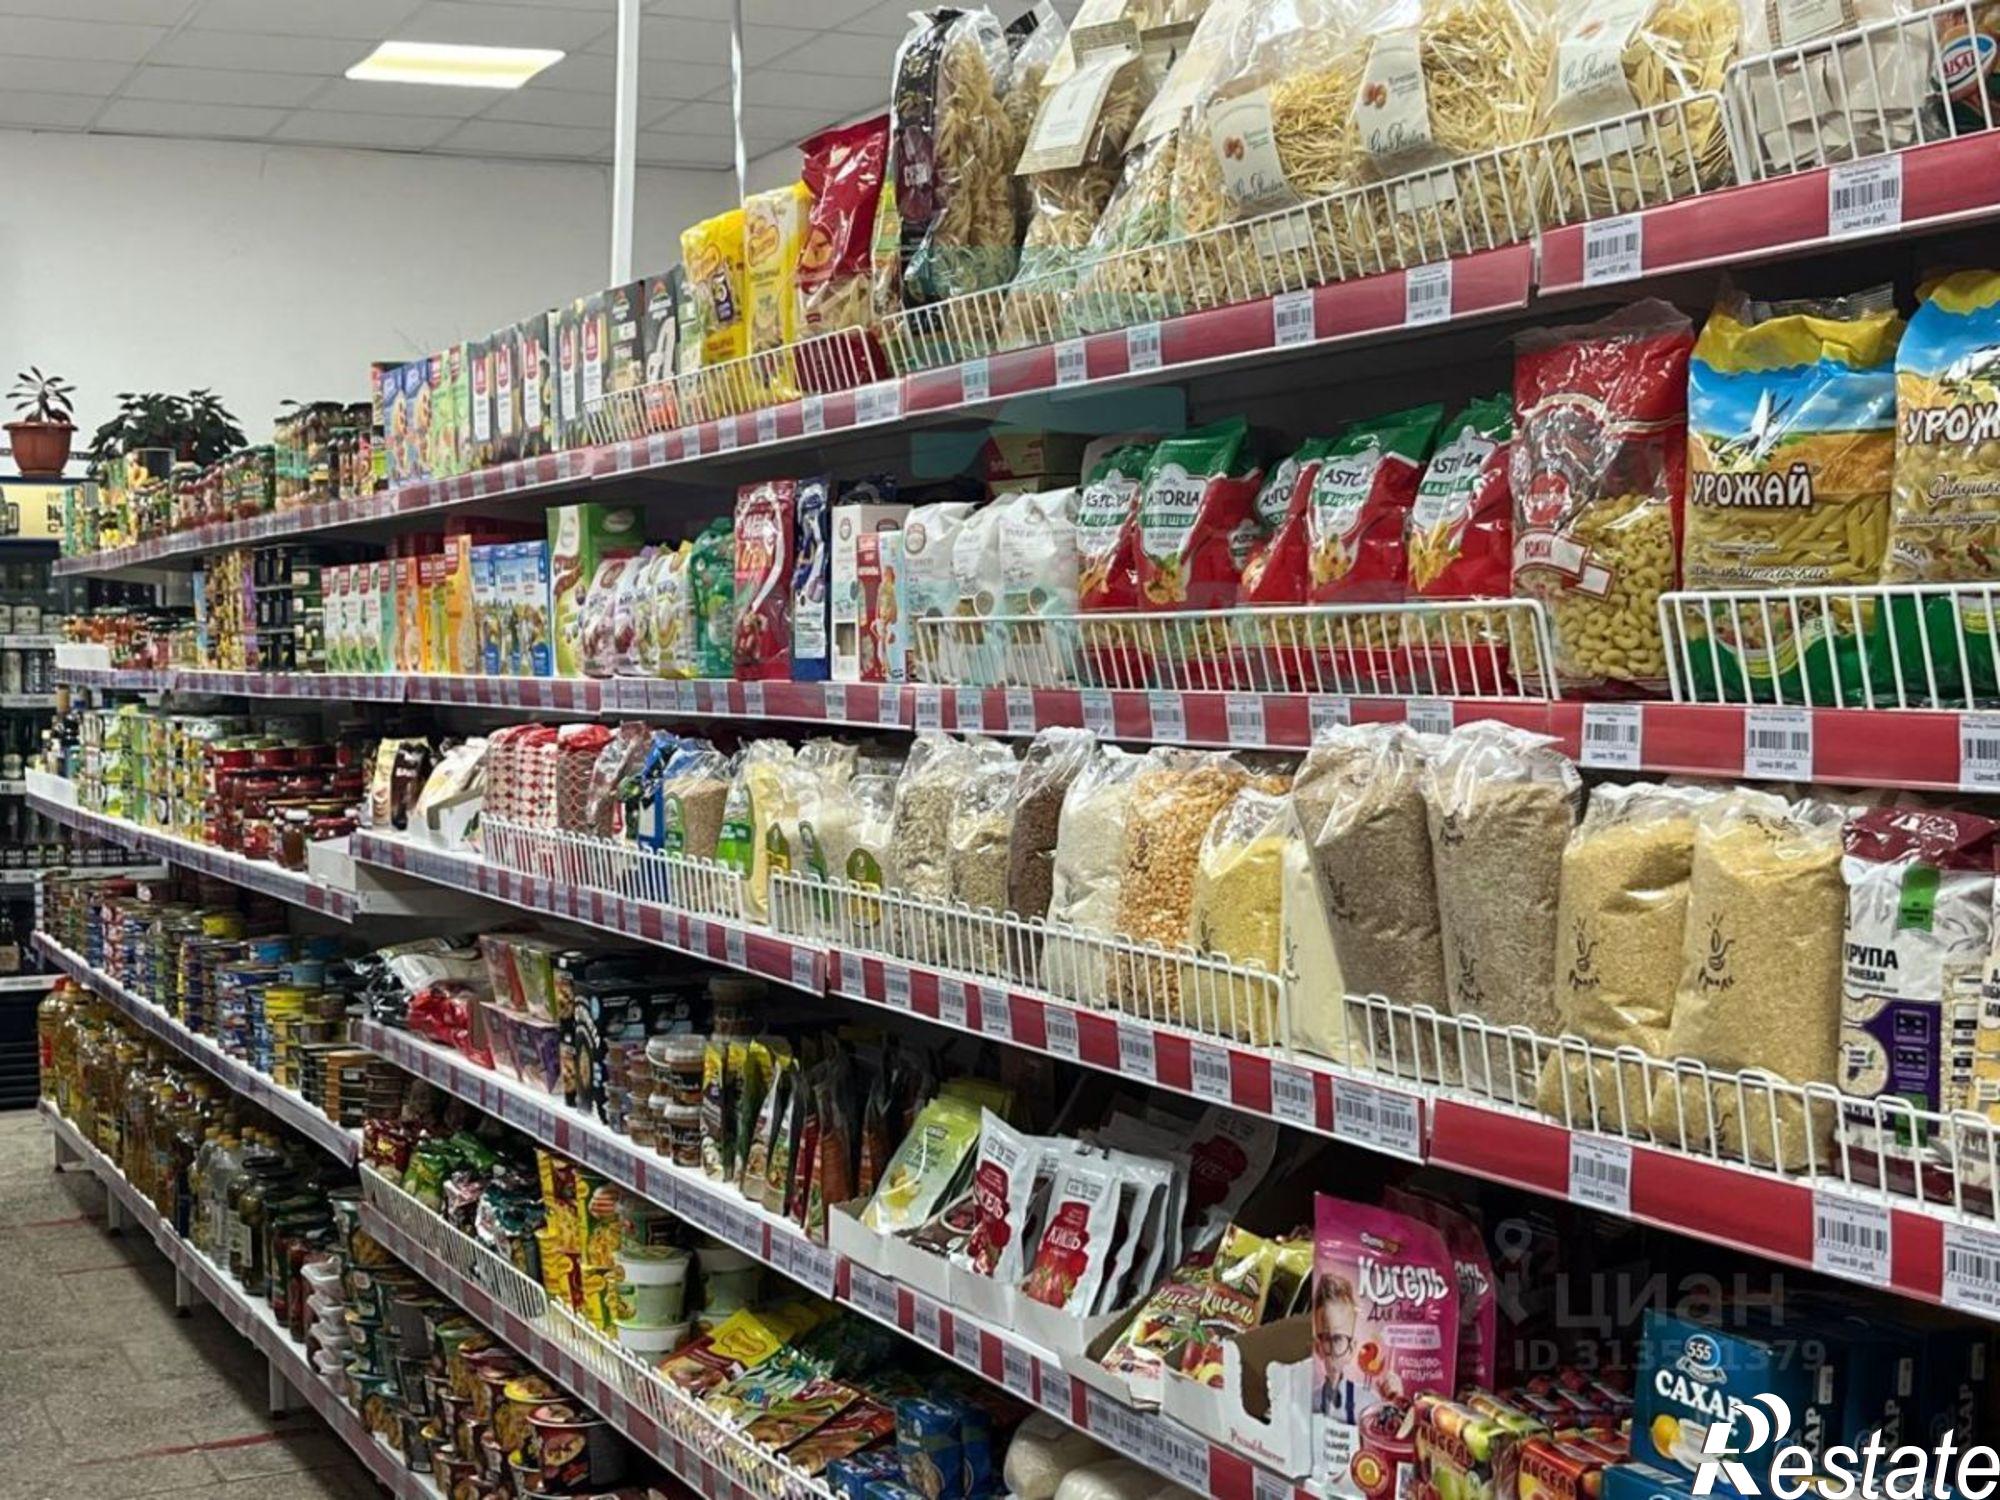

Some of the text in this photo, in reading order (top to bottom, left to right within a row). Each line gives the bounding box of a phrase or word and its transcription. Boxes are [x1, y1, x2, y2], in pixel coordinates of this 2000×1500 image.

[1147, 489, 1200, 507] ATORIA
[1692, 464, 1812, 507] УРОЖАЙ
[1151, 1286, 1201, 1308] Кисе
[1357, 1255, 1449, 1307] Кисель
[1654, 1369, 1745, 1438] САХАР
